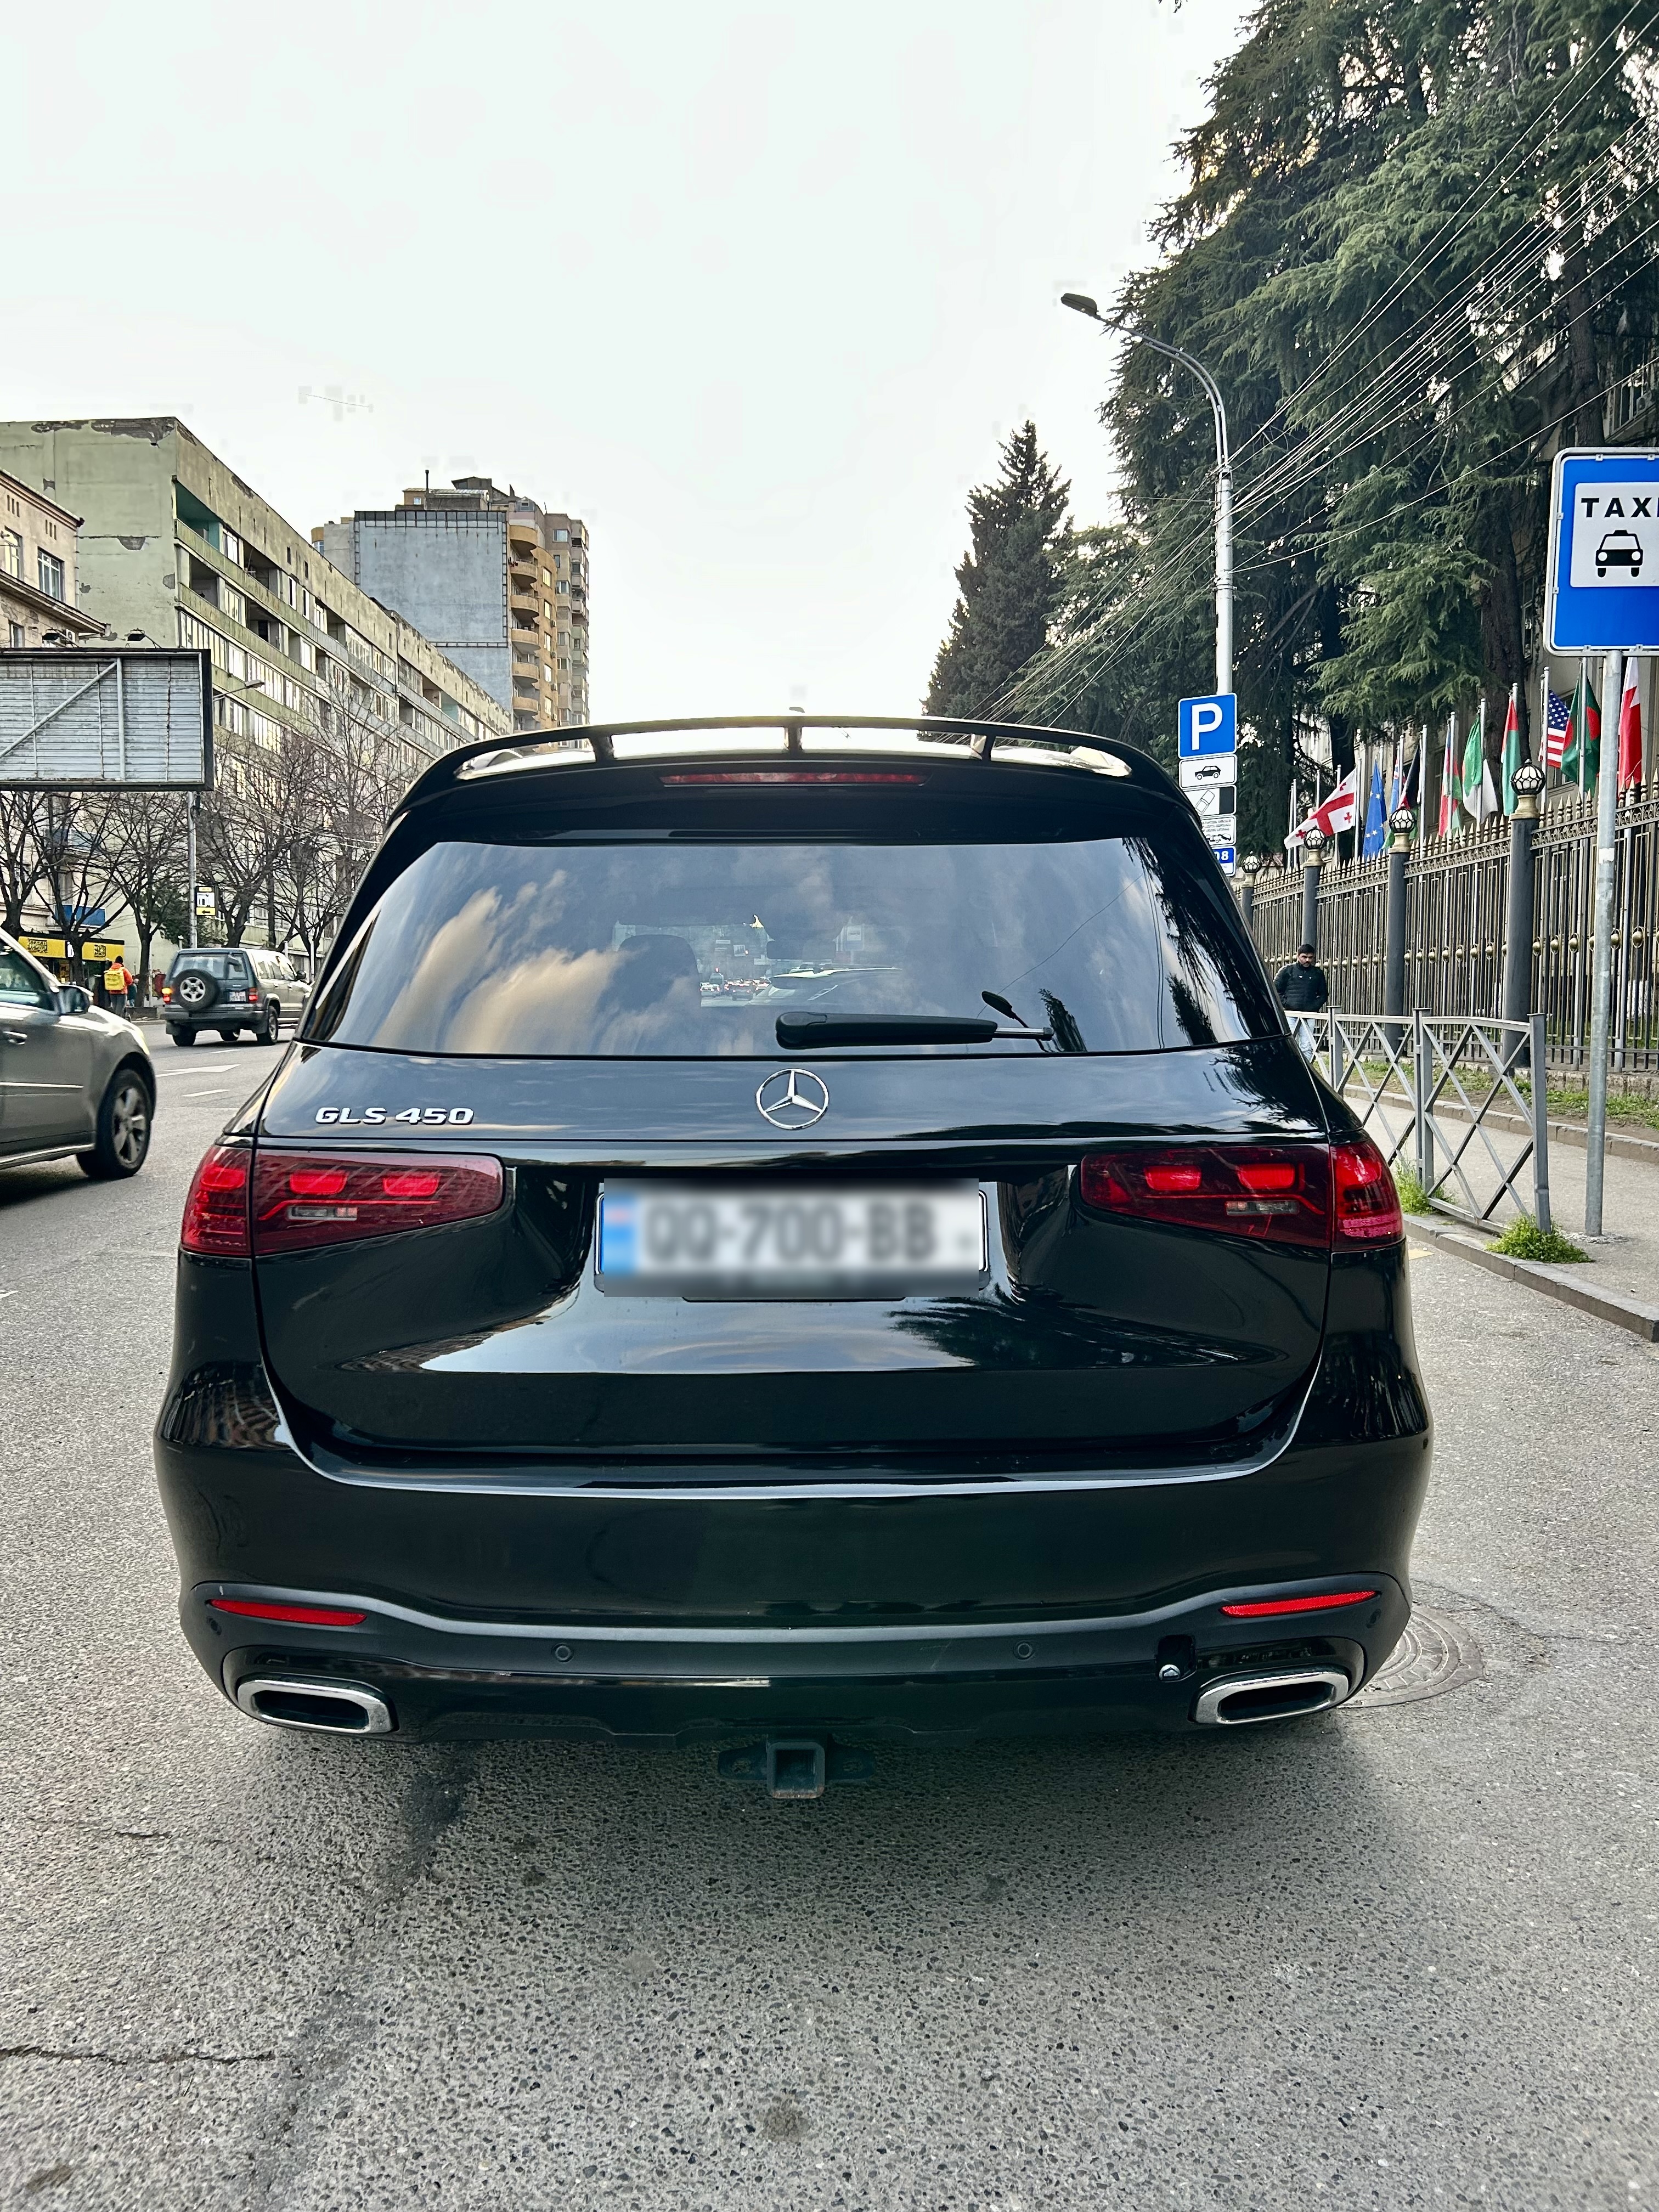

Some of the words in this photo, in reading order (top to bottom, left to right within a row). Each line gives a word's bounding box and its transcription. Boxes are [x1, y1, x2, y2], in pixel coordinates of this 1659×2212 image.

[1192, 703, 1223, 751] P
[315, 1107, 387, 1125] GLS
[395, 1107, 474, 1125] 450
